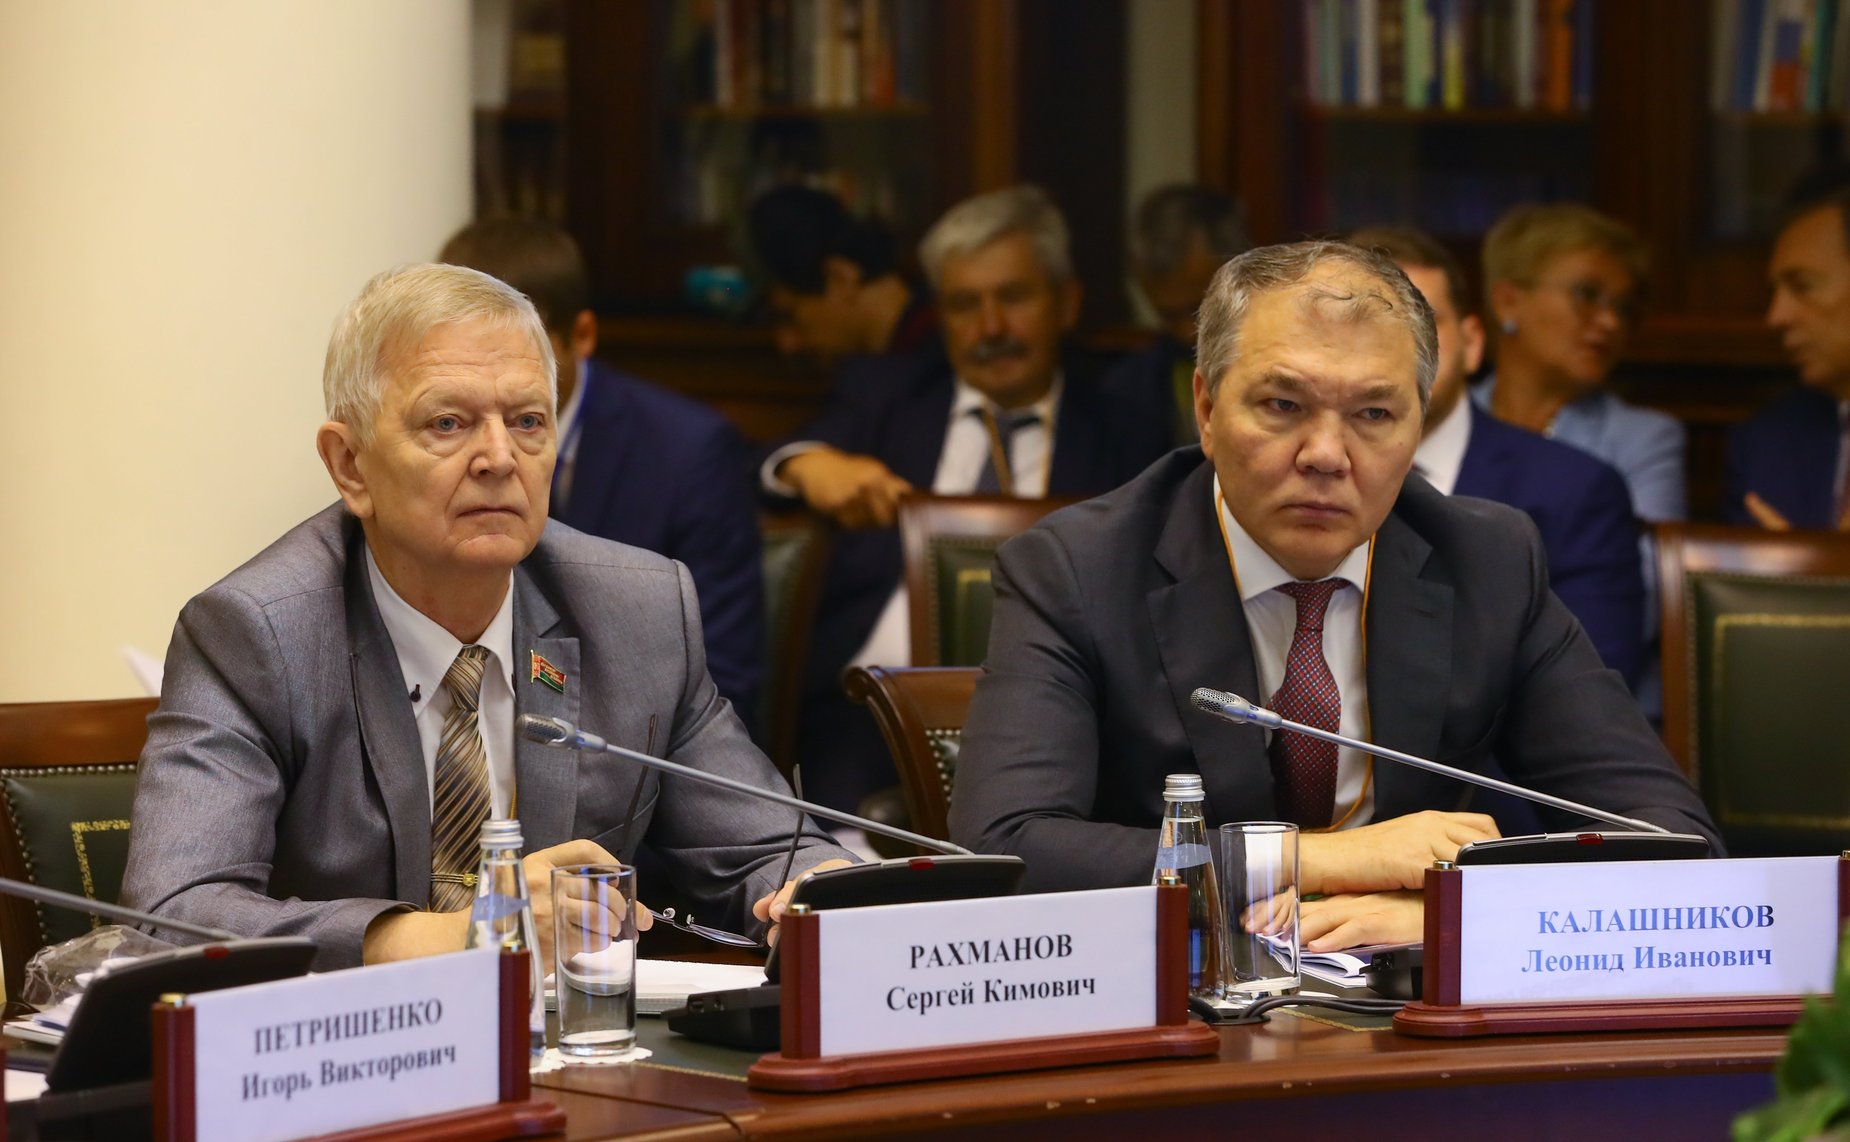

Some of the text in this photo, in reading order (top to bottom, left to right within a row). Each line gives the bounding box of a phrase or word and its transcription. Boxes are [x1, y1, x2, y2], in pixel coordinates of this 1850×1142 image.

[1537, 904, 1775, 934] КАЛАШНИКОВ
[909, 933, 1074, 970] РАХМАНОВ
[1520, 945, 1773, 973] Леонид Иванович
[886, 976, 1096, 1016] Сергей Кимович
[254, 998, 443, 1055] ПЕТРИШЕНКО
[241, 1045, 456, 1101] Игорь Викторович
